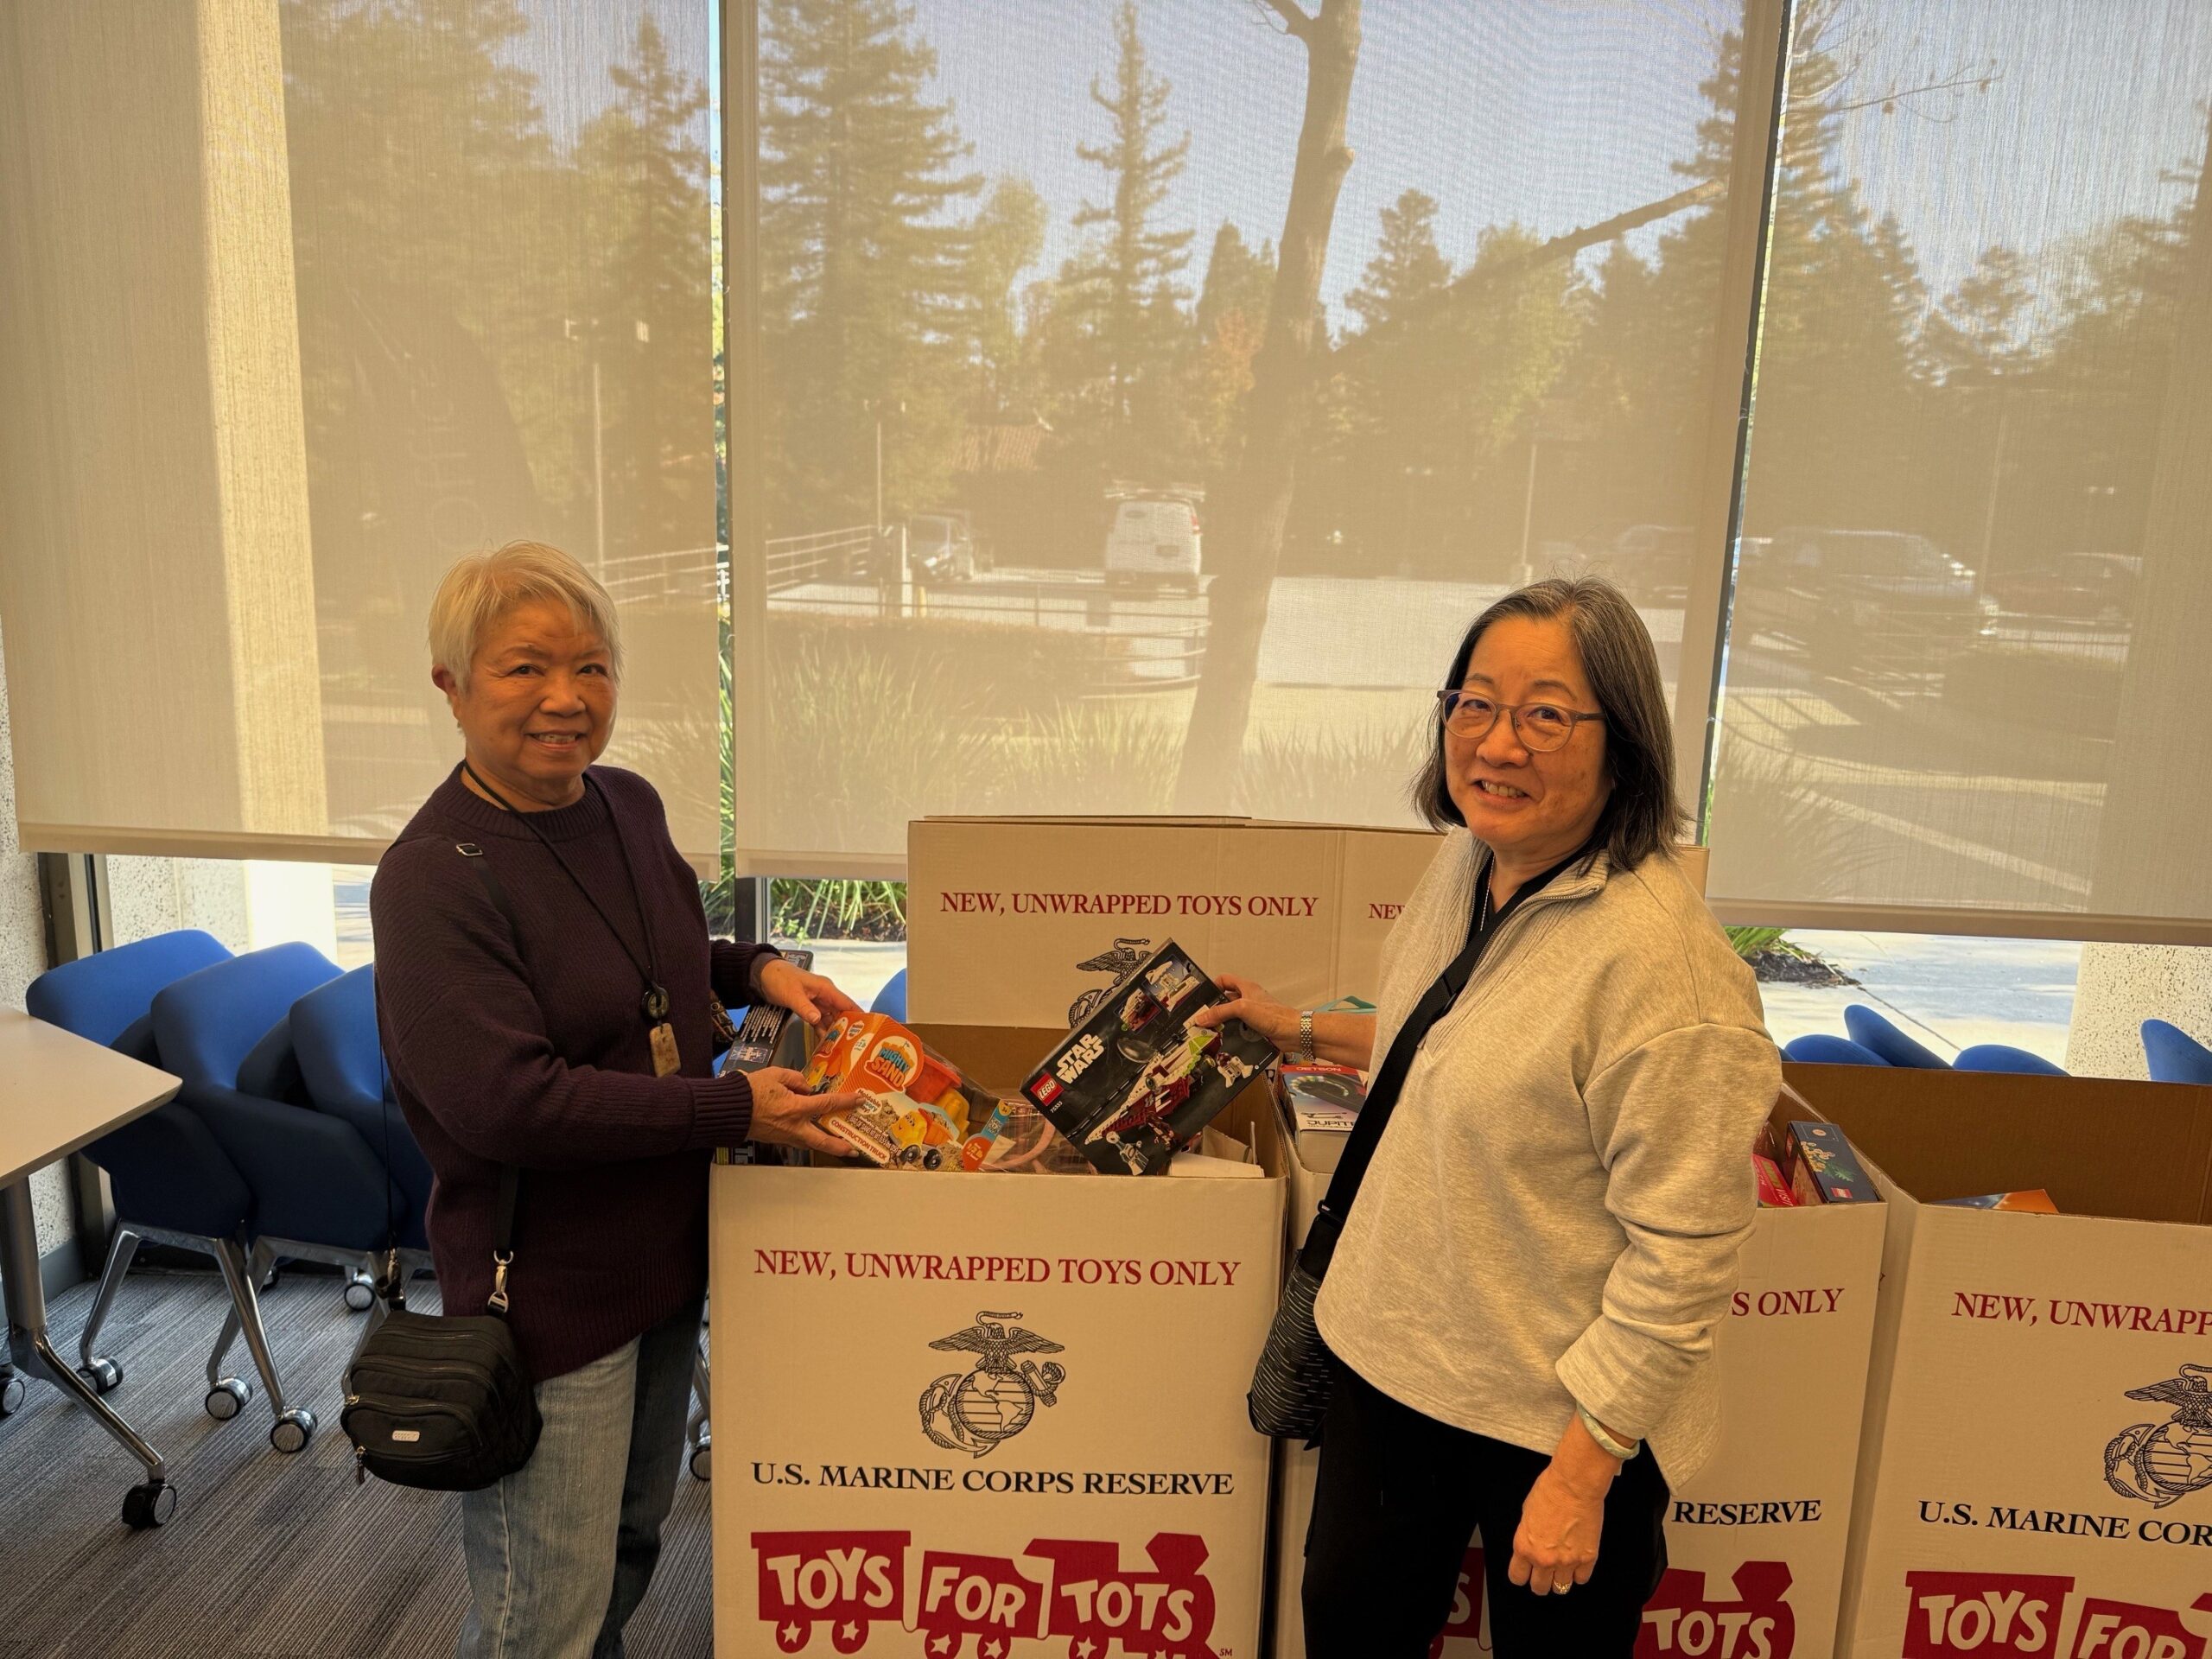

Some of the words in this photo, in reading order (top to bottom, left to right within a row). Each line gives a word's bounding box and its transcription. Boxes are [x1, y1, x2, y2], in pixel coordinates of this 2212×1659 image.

[941, 893, 1005, 916] NEW,
[1013, 893, 1172, 915] UNWRAPPED
[1177, 895, 1242, 916] TOYS
[1248, 896, 1319, 917] ONLY
[879, 1046, 911, 1074] MIGHTY
[1056, 1033, 1099, 1077] STAR
[1059, 1038, 1104, 1084] WARS
[871, 1056, 906, 1088] SAND
[858, 1089, 881, 1107] Moldable
[1038, 1078, 1056, 1100] LEGO
[831, 1119, 871, 1149] CONSTRUCTION
[869, 1146, 887, 1160] TRUCK
[754, 1249, 836, 1280] NEW,
[845, 1252, 1051, 1283] UNWRAPPED
[1058, 1259, 1141, 1286] TOYS
[1149, 1260, 1242, 1287] ONLY
[1758, 1288, 1845, 1317] ONLY
[1951, 1292, 2037, 1326] NEW,
[752, 1463, 811, 1485] U.S.
[819, 1465, 955, 1491] MARINE
[962, 1470, 1075, 1494] CORPS
[1082, 1472, 1234, 1496] RESERVE
[1671, 1500, 1822, 1526] RESERVE
[1918, 1501, 1979, 1527] U.S.
[1987, 1506, 2131, 1539] MARINE
[766, 1547, 895, 1610] TOYS
[925, 1566, 1027, 1628] FOR
[1060, 1579, 1196, 1643] TOTS
[1642, 1607, 1776, 1659] TOTS
[1918, 1590, 2050, 1652] TOYS
[1219, 1648, 1233, 1656] SM
